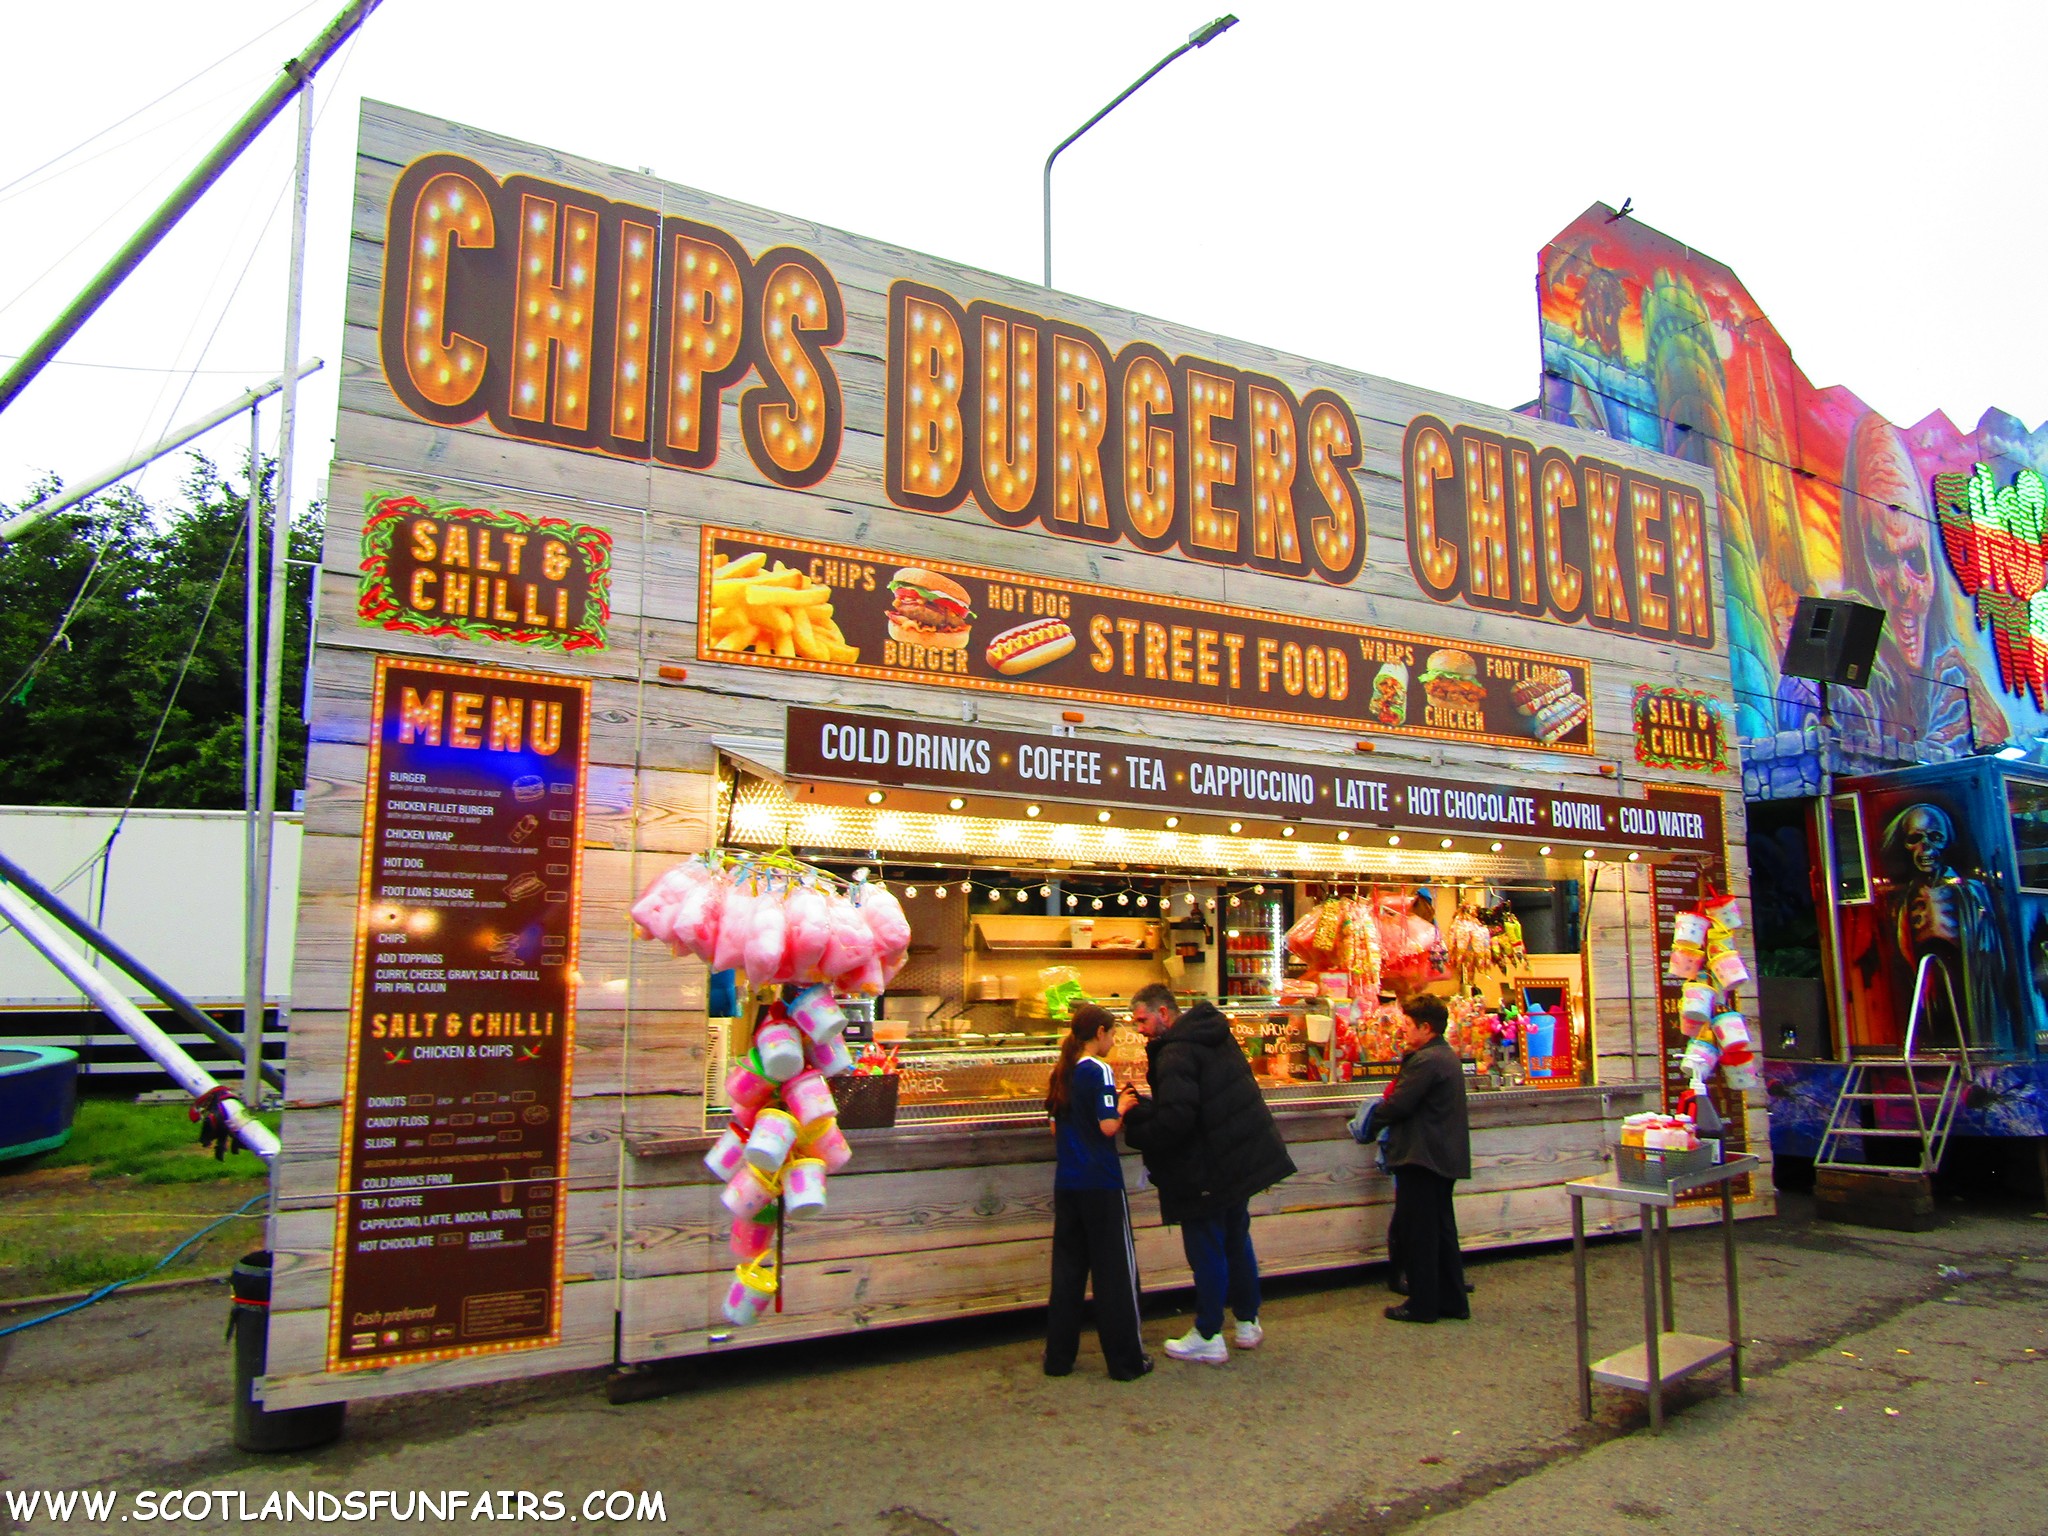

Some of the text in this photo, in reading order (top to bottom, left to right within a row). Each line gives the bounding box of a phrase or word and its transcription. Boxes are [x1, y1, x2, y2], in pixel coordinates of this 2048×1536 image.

[403, 171, 828, 472] CHIPS
[901, 294, 1356, 572] BURGERS
[1412, 426, 1709, 639] CHICKEN
[411, 519, 572, 581] SALT &
[809, 557, 877, 592] CHIPS
[410, 567, 569, 629] CHILLI
[988, 584, 1071, 619] HOT DOG
[883, 638, 969, 675] BURGER
[1089, 613, 1349, 701] STREET FOOD
[1359, 638, 1416, 668] WRAPS
[1486, 657, 1561, 686] FOOT LONG
[398, 686, 563, 756] MENU
[1424, 705, 1486, 732] CHICKEN
[1648, 697, 1709, 731] SALT &
[1650, 727, 1712, 760] CHILLI
[389, 771, 427, 784] BURGER
[821, 723, 1704, 840] COLD DRINKS COFFEE TEA CAPPUCCINO LATTE HOT CHOCOLATE BOVRIL COLD WATER
[387, 800, 494, 816] CHICKEN FILLET BURGER
[385, 828, 454, 842] CHICKEN WRAP
[383, 857, 424, 868] HOT DOG
[381, 886, 474, 899] FOOT LONG SAUSAGE
[378, 933, 407, 944] CHIPS
[376, 953, 443, 964] ADD TOPPINGS
[375, 969, 540, 981] CURRY, CHEESE, GRAVY, SALT & CHILLI,
[374, 983, 447, 994] PIRI PIRI, CAJUN
[371, 1012, 554, 1038] SALT & CHILLI
[1260, 1022, 1300, 1037] NACHOS
[413, 1044, 514, 1059] CHICKEN & CHIPS
[898, 1076, 949, 1095] URGER
[367, 1096, 407, 1108] DONUTS
[366, 1116, 399, 1128] CANDY
[399, 1115, 430, 1127] FLOSS
[365, 1137, 397, 1149] SLUSH
[362, 1174, 453, 1189] COLD DRINKS FROM
[361, 1197, 379, 1209] TEA
[388, 1196, 423, 1208] COFFEE
[359, 1218, 422, 1231] CAPPUCCINO,
[423, 1214, 453, 1227] LATTE,
[491, 1208, 523, 1221] BOVRIL
[358, 1230, 504, 1252] HOT CHOCOLATE DELUXE
[353, 1304, 437, 1326] Cash preferred
